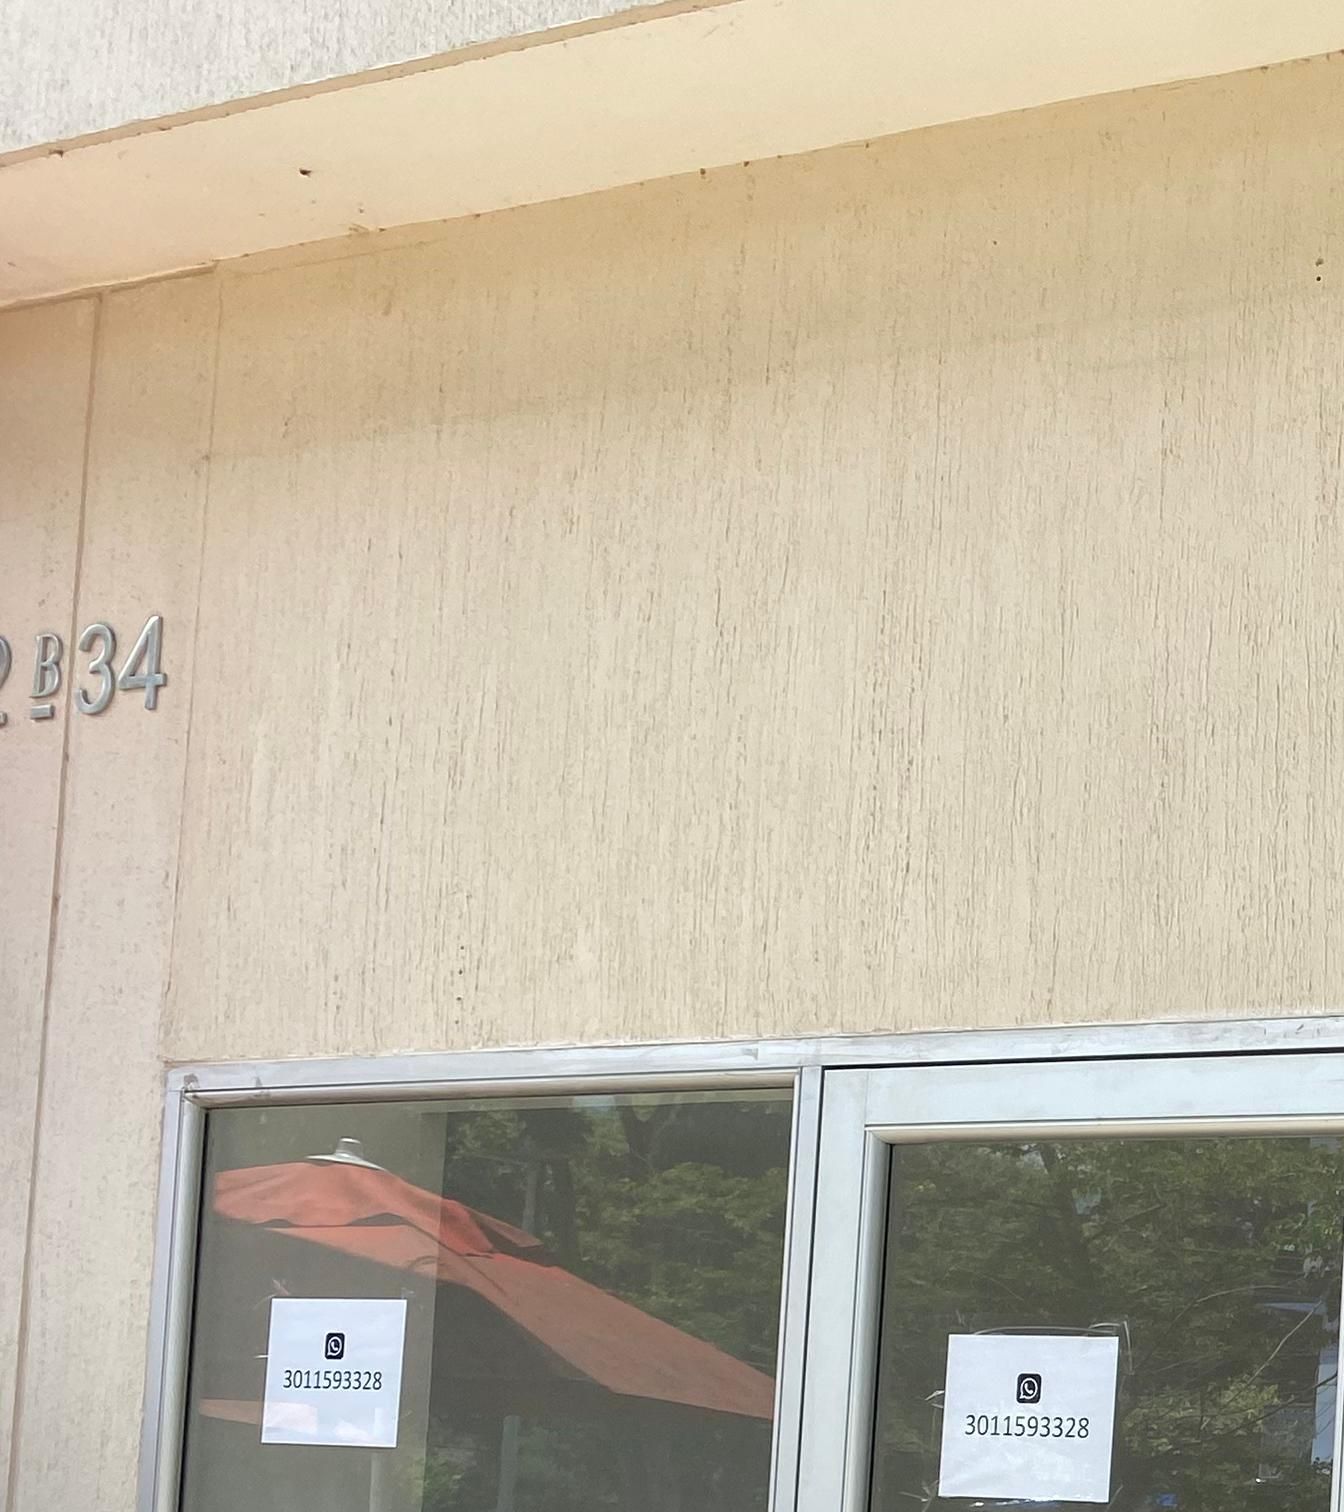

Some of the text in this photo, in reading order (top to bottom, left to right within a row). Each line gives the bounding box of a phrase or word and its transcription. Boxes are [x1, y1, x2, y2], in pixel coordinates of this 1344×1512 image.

[75, 615, 167, 715] 34
[283, 1369, 383, 1391] 3011593328
[964, 1414, 1090, 1439] 3011593328
